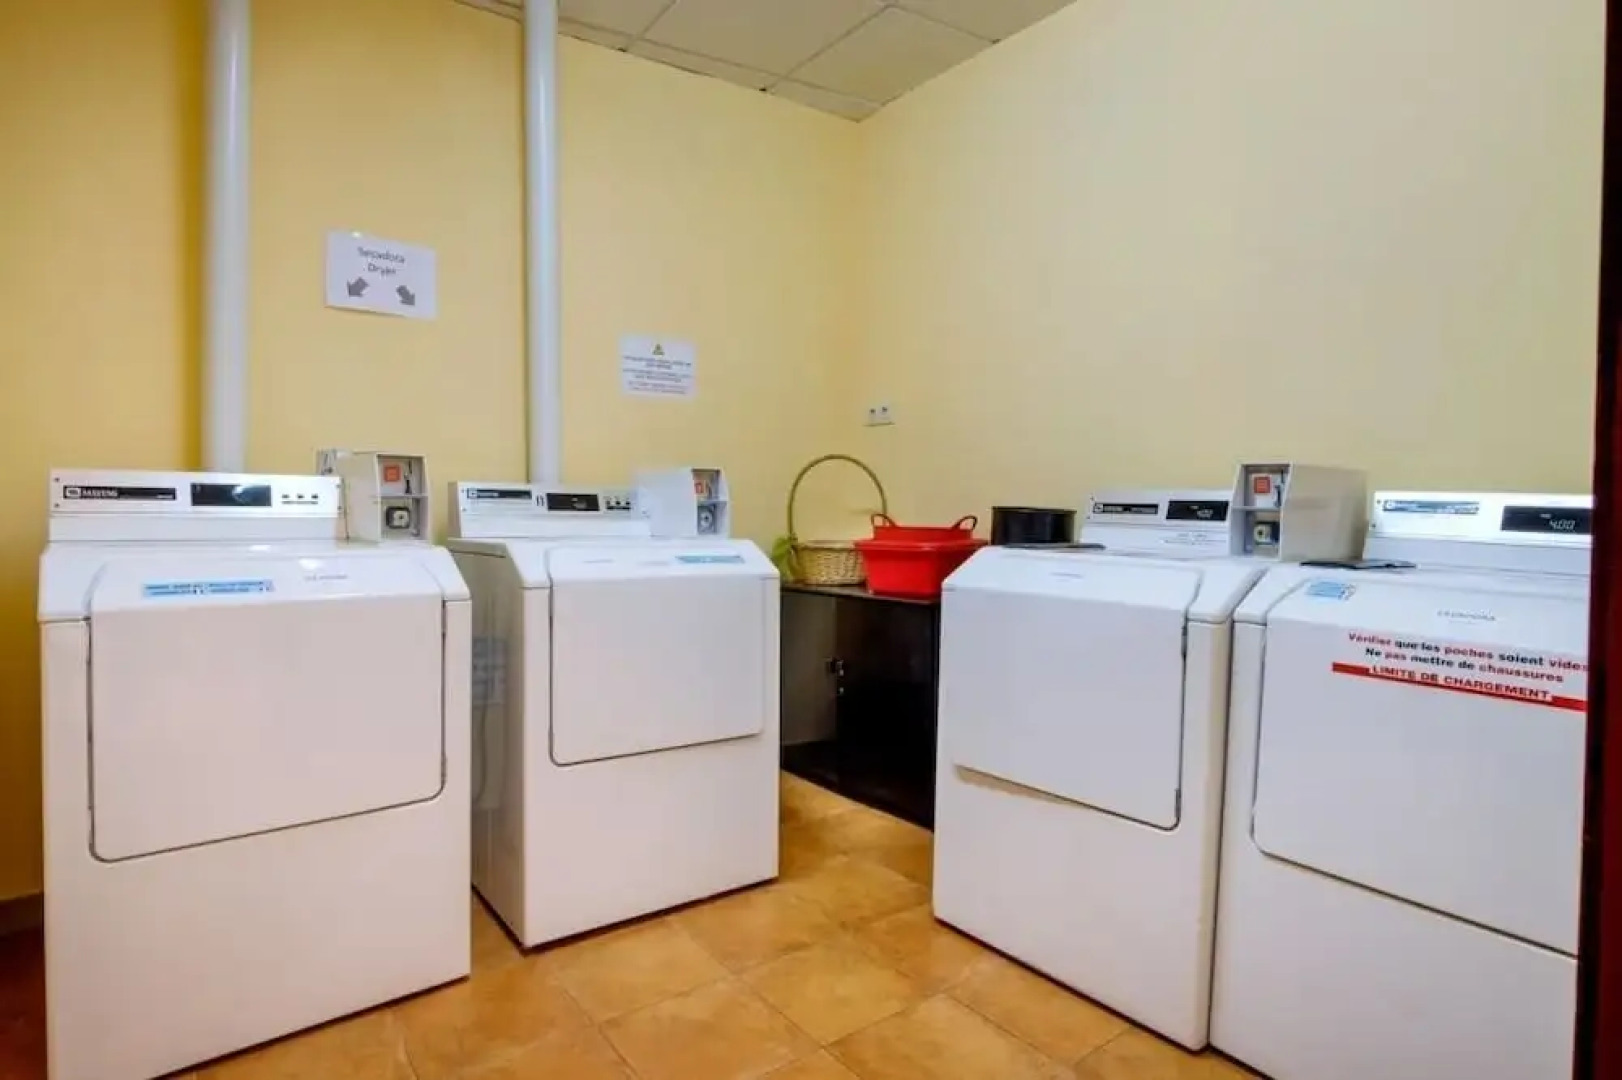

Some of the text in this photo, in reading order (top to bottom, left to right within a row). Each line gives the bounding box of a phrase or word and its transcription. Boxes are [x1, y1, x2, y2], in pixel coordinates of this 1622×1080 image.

[1365, 647, 1382, 657] Ne
[1410, 656, 1454, 668] mettre
[1457, 661, 1475, 670] de
[1479, 664, 1564, 683] chaussures
[1421, 642, 1441, 653] les
[1444, 646, 1494, 660] poches
[1499, 652, 1544, 667] soient
[1372, 665, 1550, 699] LIMITE DE CHARGEMENT
